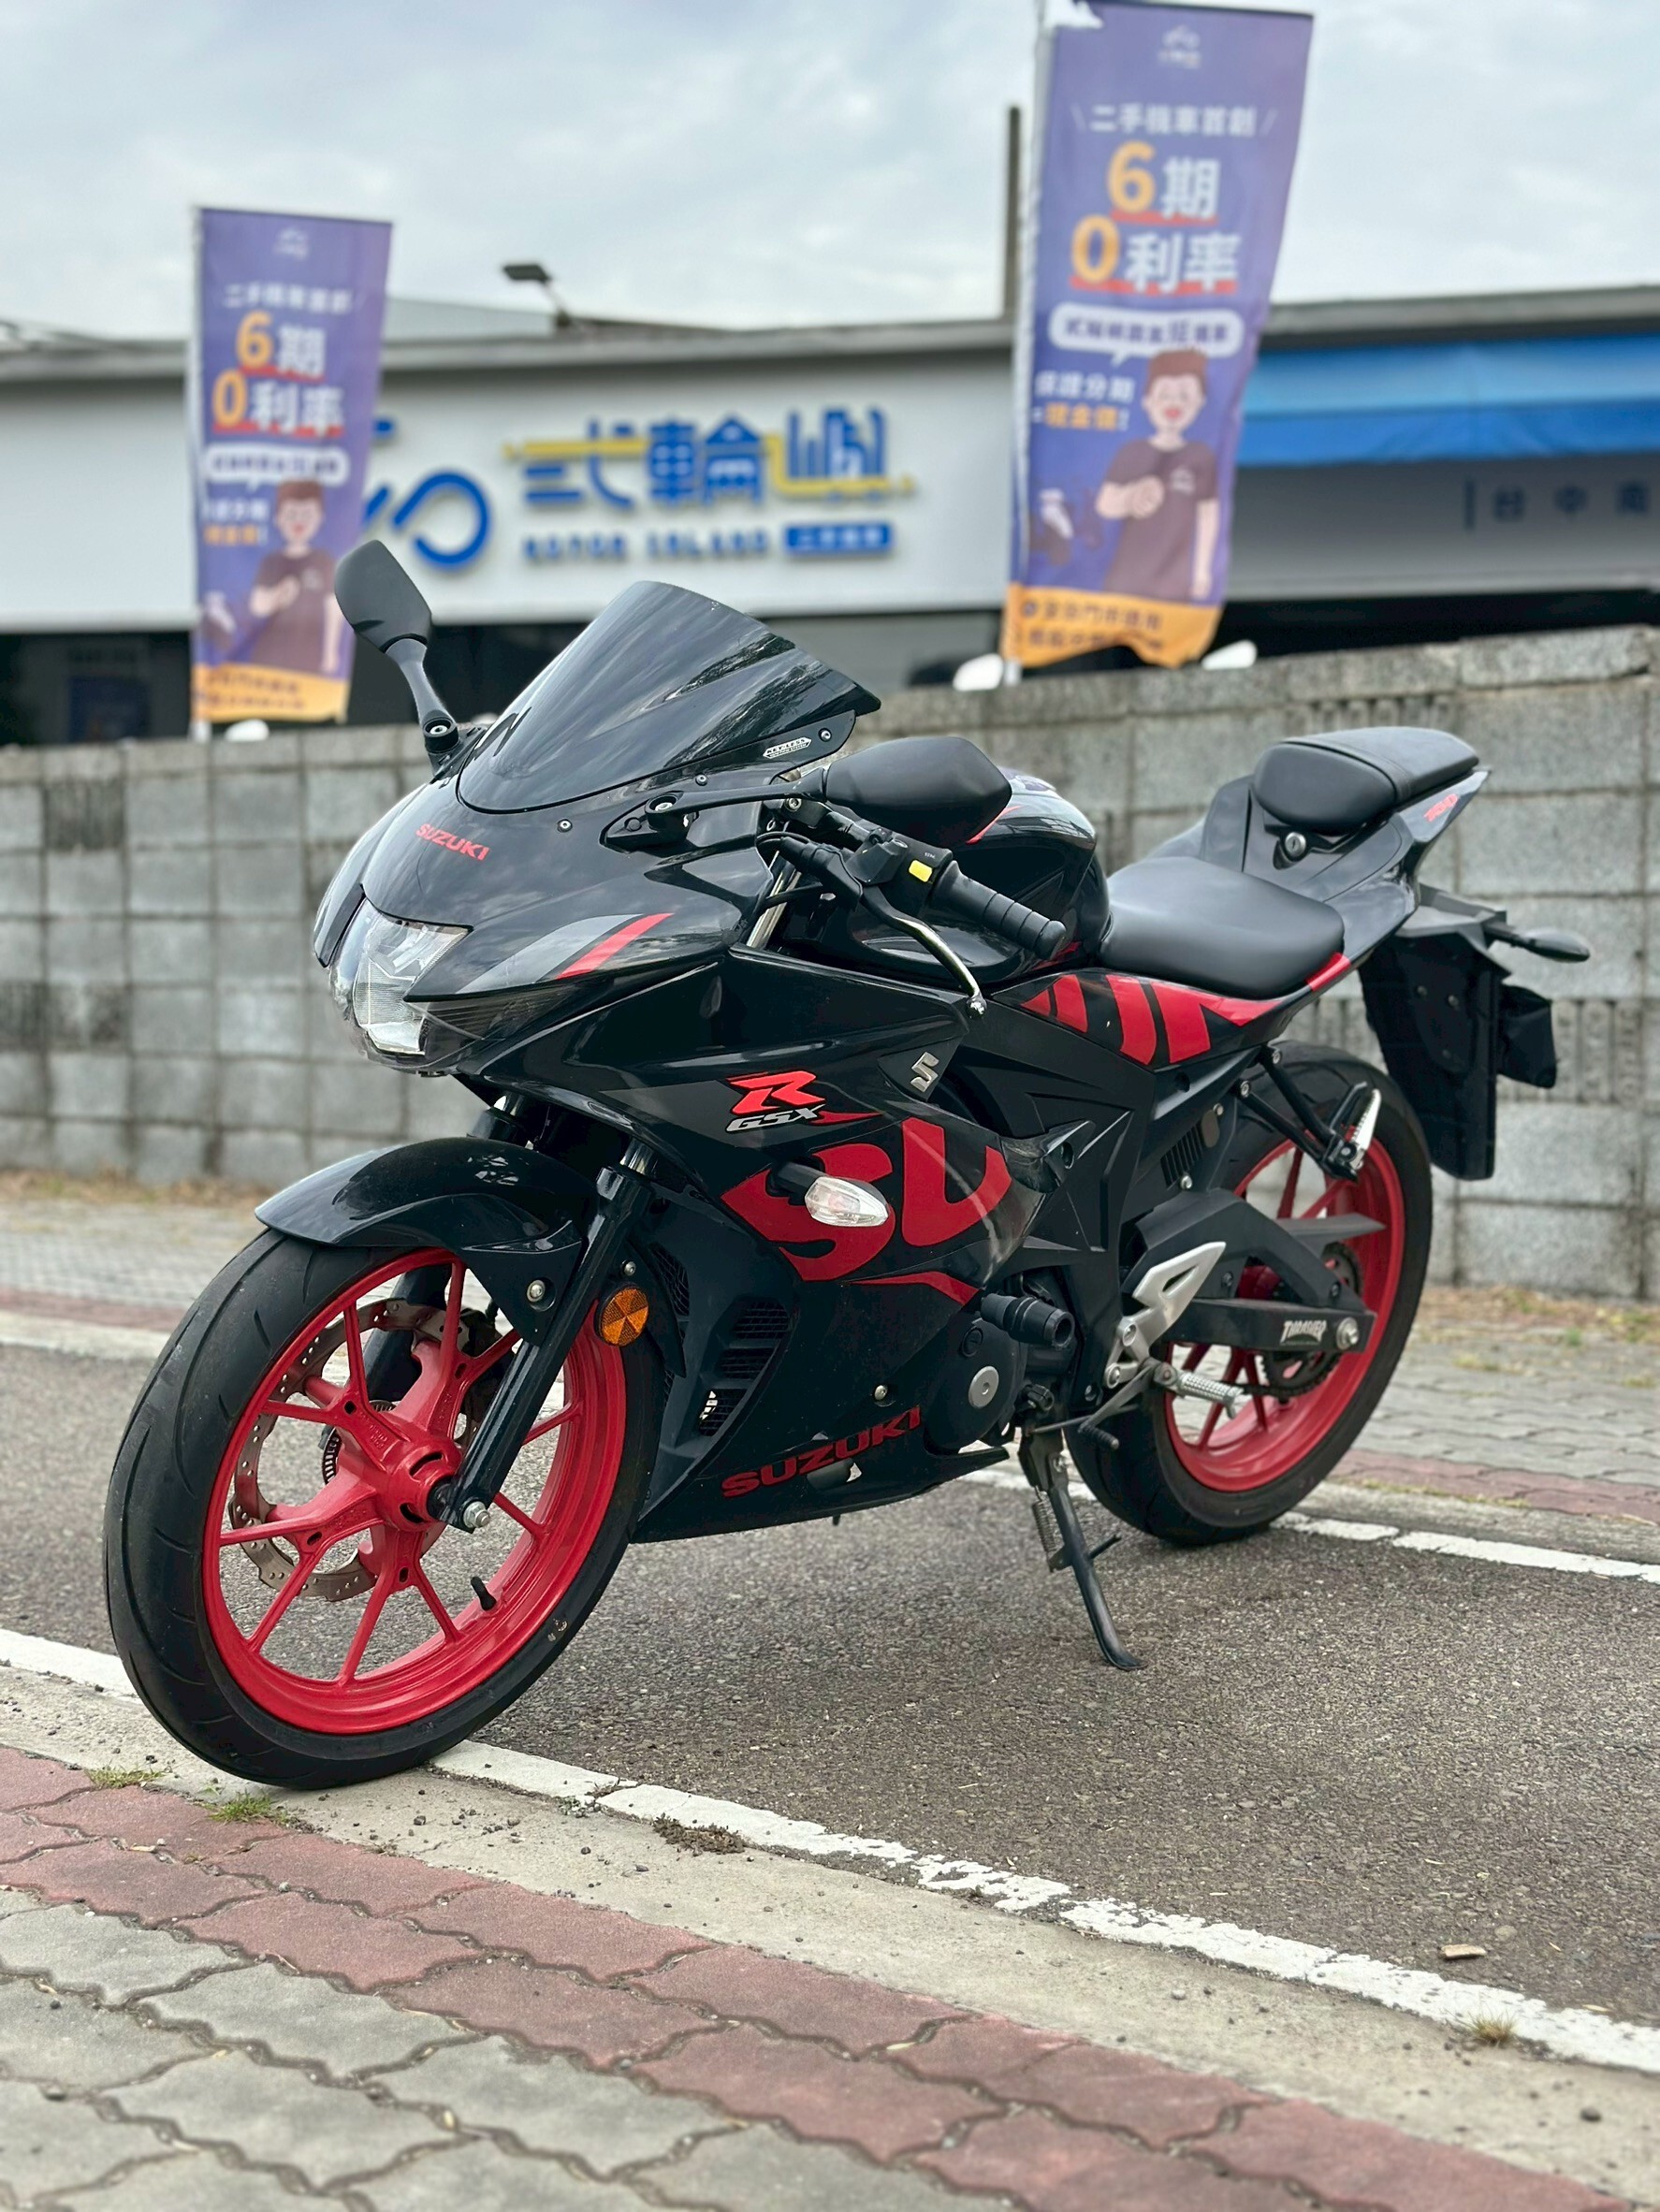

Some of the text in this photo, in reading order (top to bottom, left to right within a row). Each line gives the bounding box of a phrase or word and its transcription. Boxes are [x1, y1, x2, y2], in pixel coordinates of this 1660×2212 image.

[1107, 140, 1221, 221] 6期
[1070, 214, 1241, 292] 0利率
[415, 823, 491, 862] SUZUKI
[725, 1104, 826, 1133] GSX
[720, 1405, 922, 1499] SUZUKI
